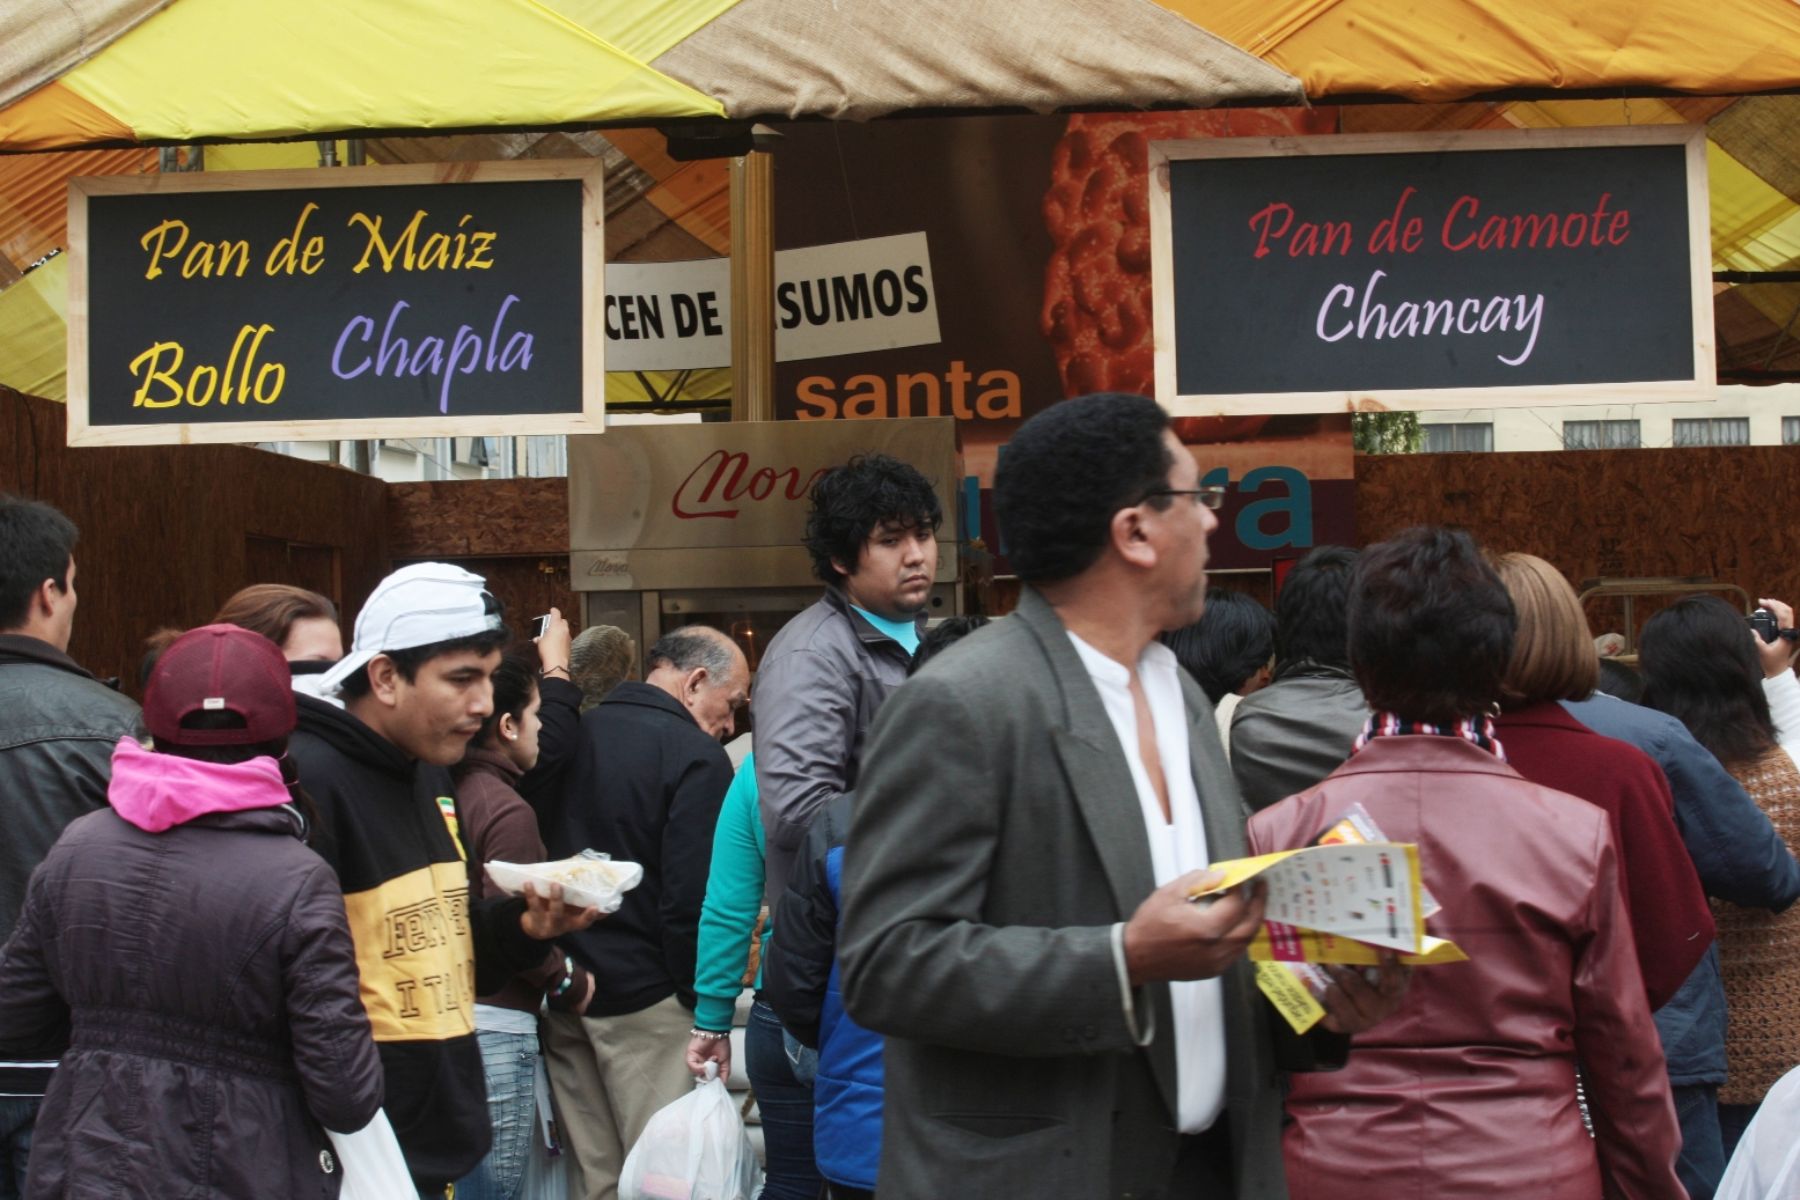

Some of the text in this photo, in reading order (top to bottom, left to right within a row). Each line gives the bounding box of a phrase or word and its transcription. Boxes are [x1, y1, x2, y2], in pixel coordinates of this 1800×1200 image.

[141, 202, 498, 281] Pan de Maíz
[1249, 187, 1631, 259] Pan de Camote
[671, 291, 723, 337] DE
[776, 265, 928, 332] SUMOS
[1316, 270, 1545, 367] Chancay
[129, 294, 535, 413] Bollo Chapla
[795, 361, 1022, 420] santa
[672, 450, 830, 520] Nov
